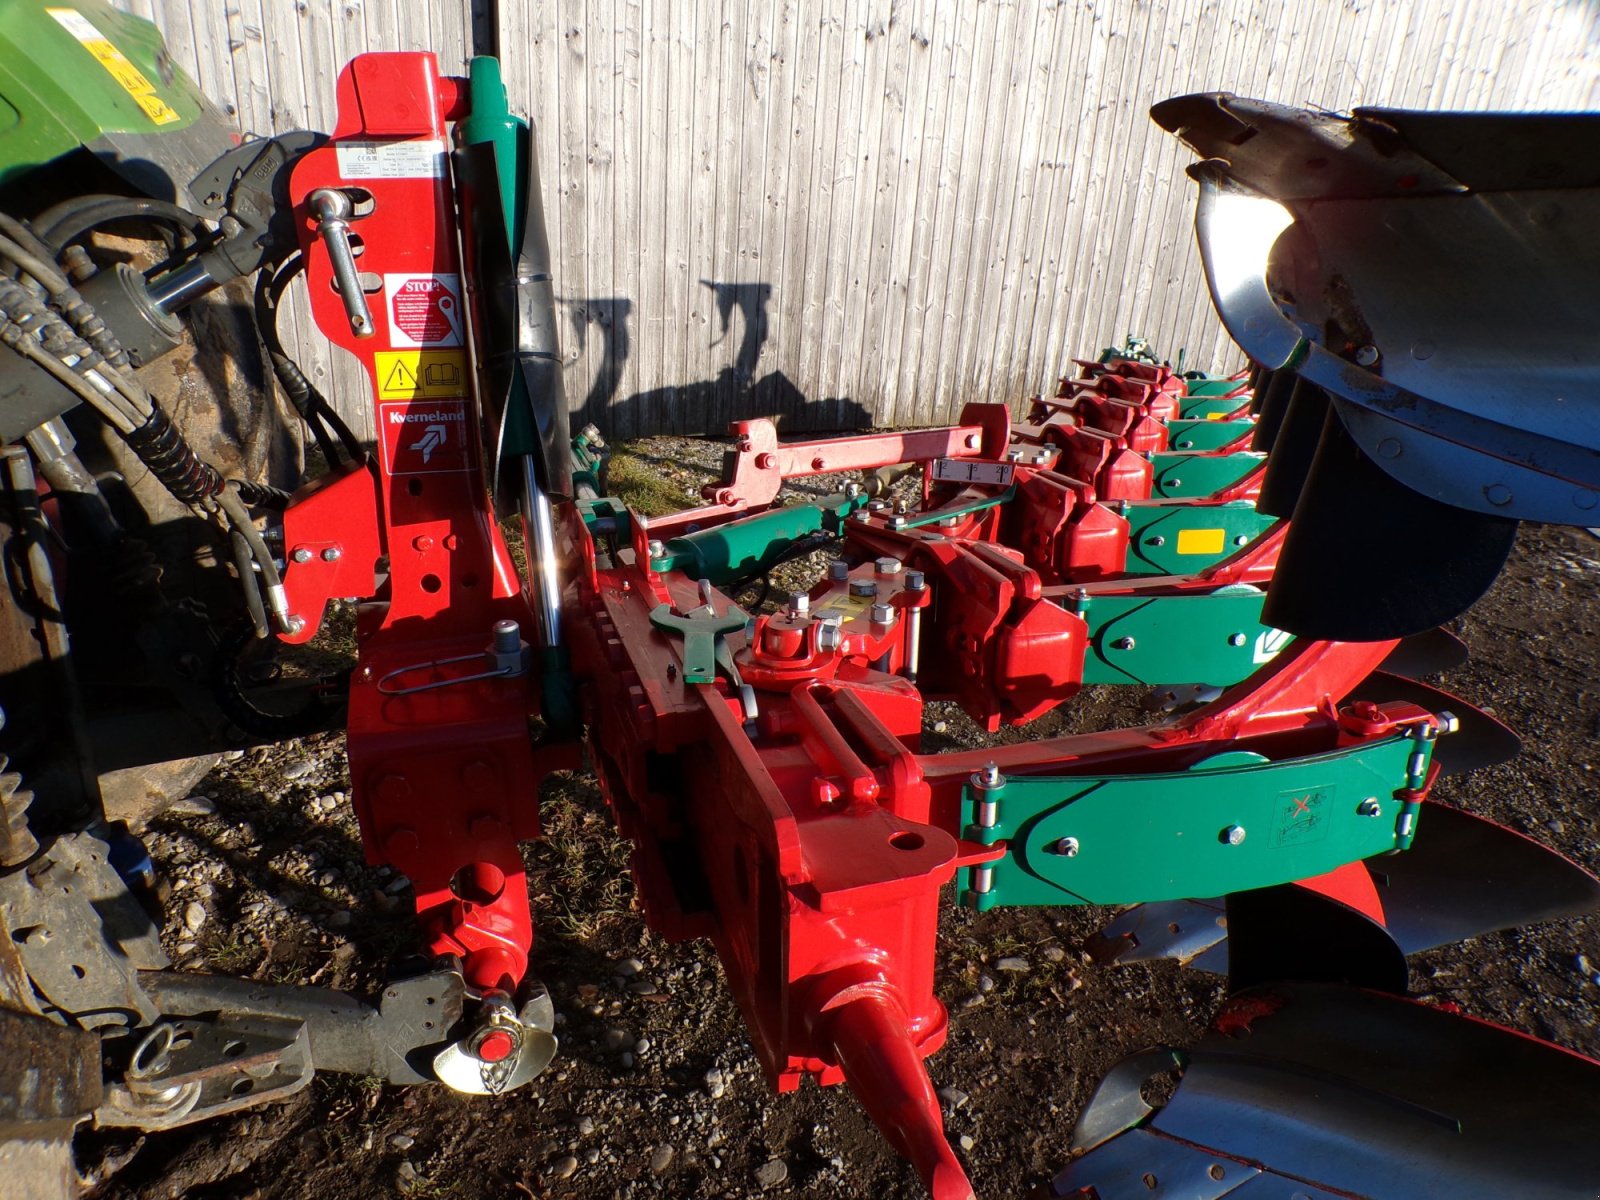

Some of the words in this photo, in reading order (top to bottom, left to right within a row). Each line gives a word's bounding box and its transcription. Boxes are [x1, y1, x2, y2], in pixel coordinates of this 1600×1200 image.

[256, 157, 277, 177] CBM
[405, 281, 440, 292] STOP!
[389, 408, 465, 424] Kverneland
